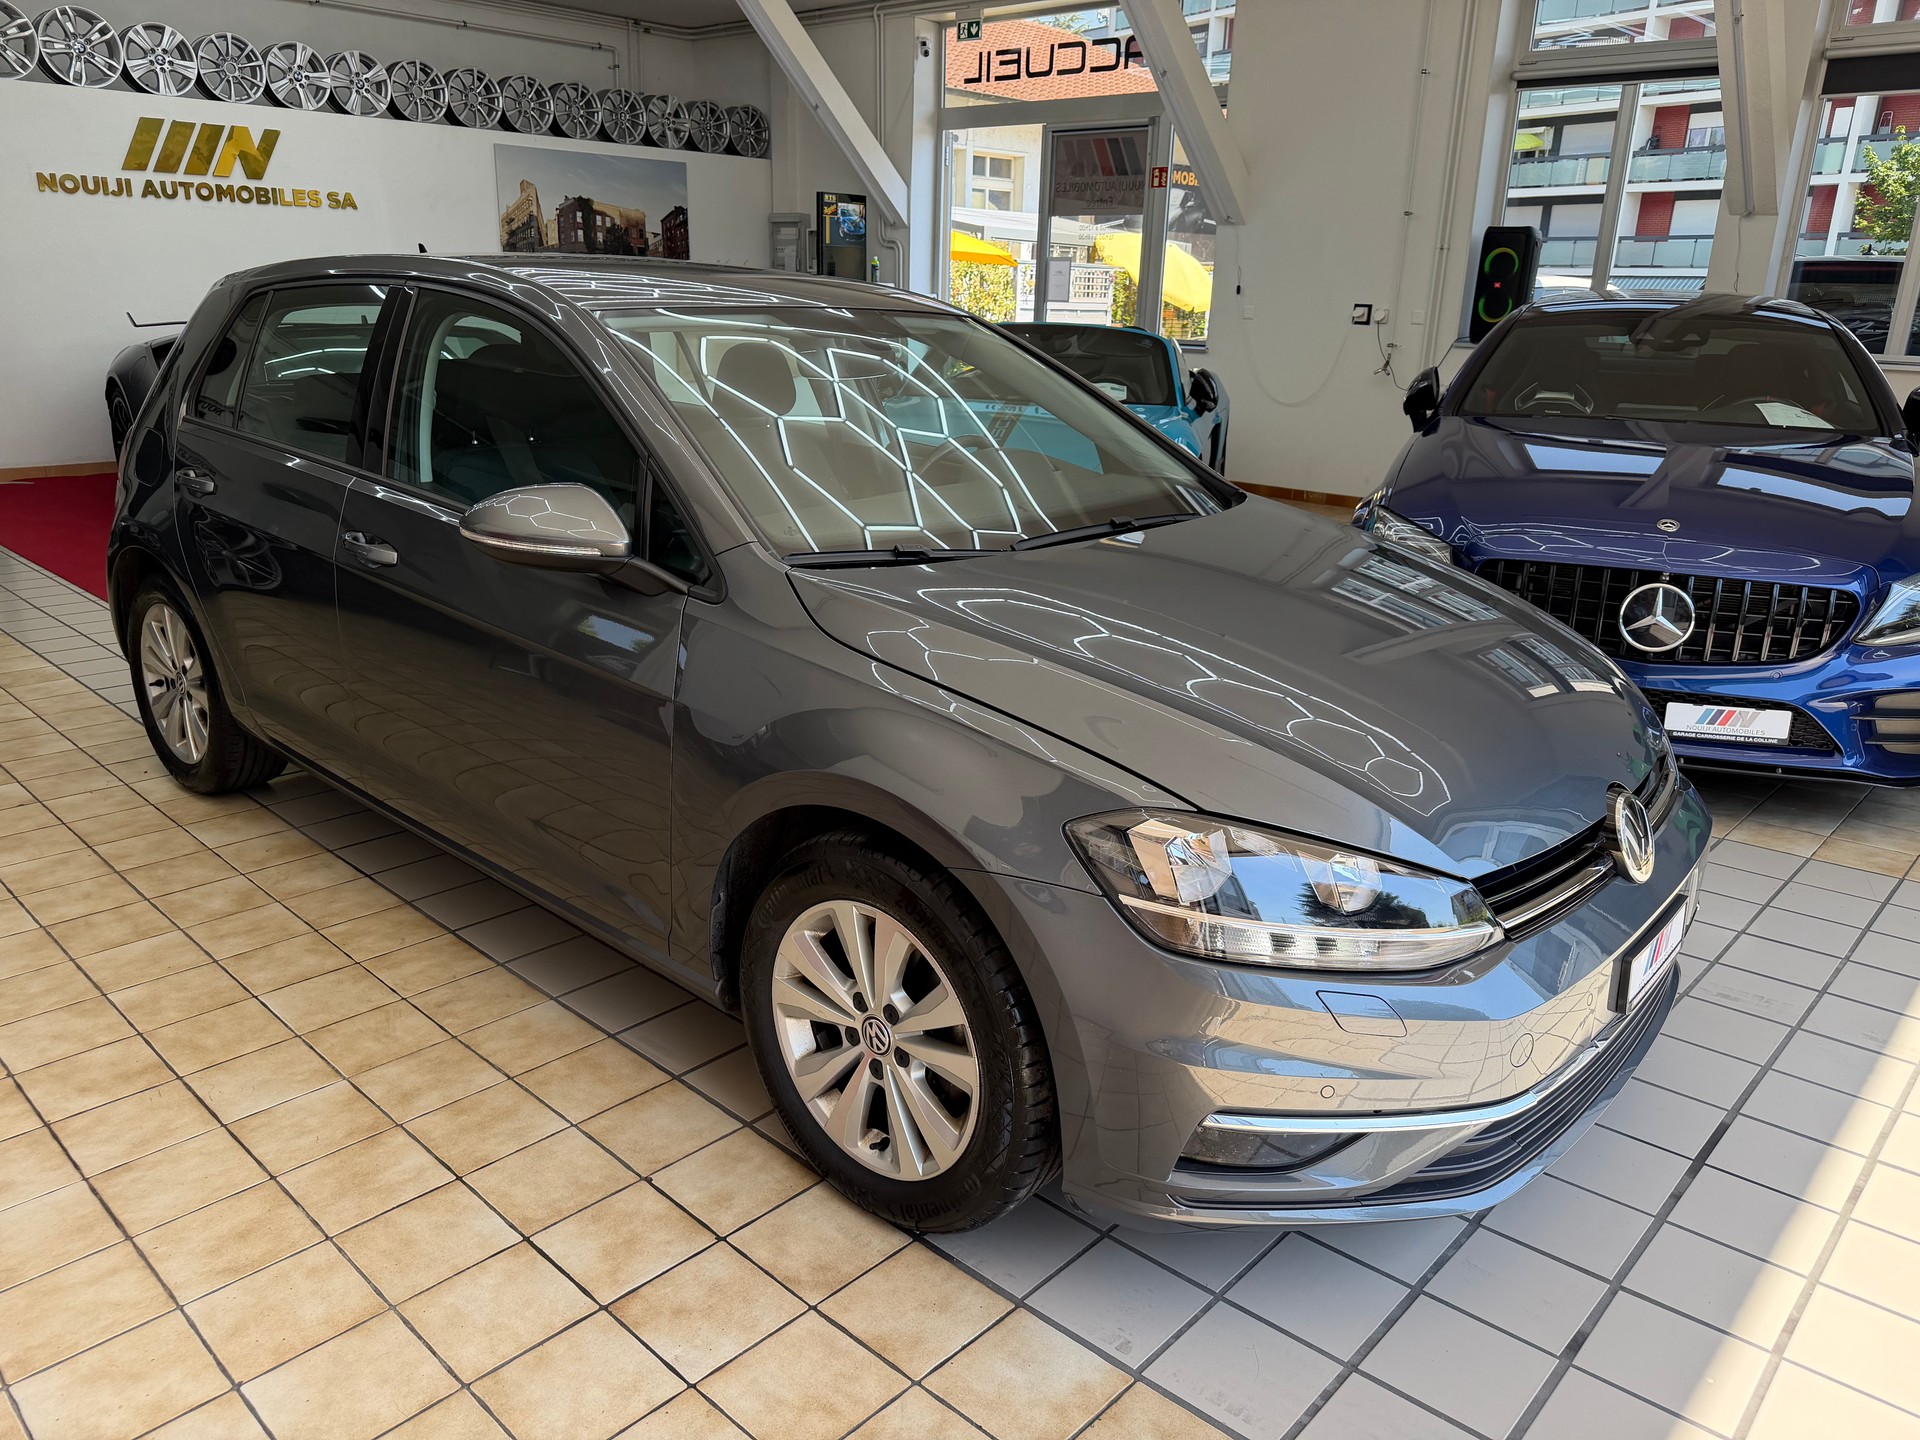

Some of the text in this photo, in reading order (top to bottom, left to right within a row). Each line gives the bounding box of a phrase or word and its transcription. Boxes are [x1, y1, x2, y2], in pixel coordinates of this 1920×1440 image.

[1172, 170, 1200, 186] MOB
[36, 172, 359, 210] NOUIJI AUTOMOBILES SA
[1686, 724, 1766, 736] NOUIJI AUTOMOBILES
